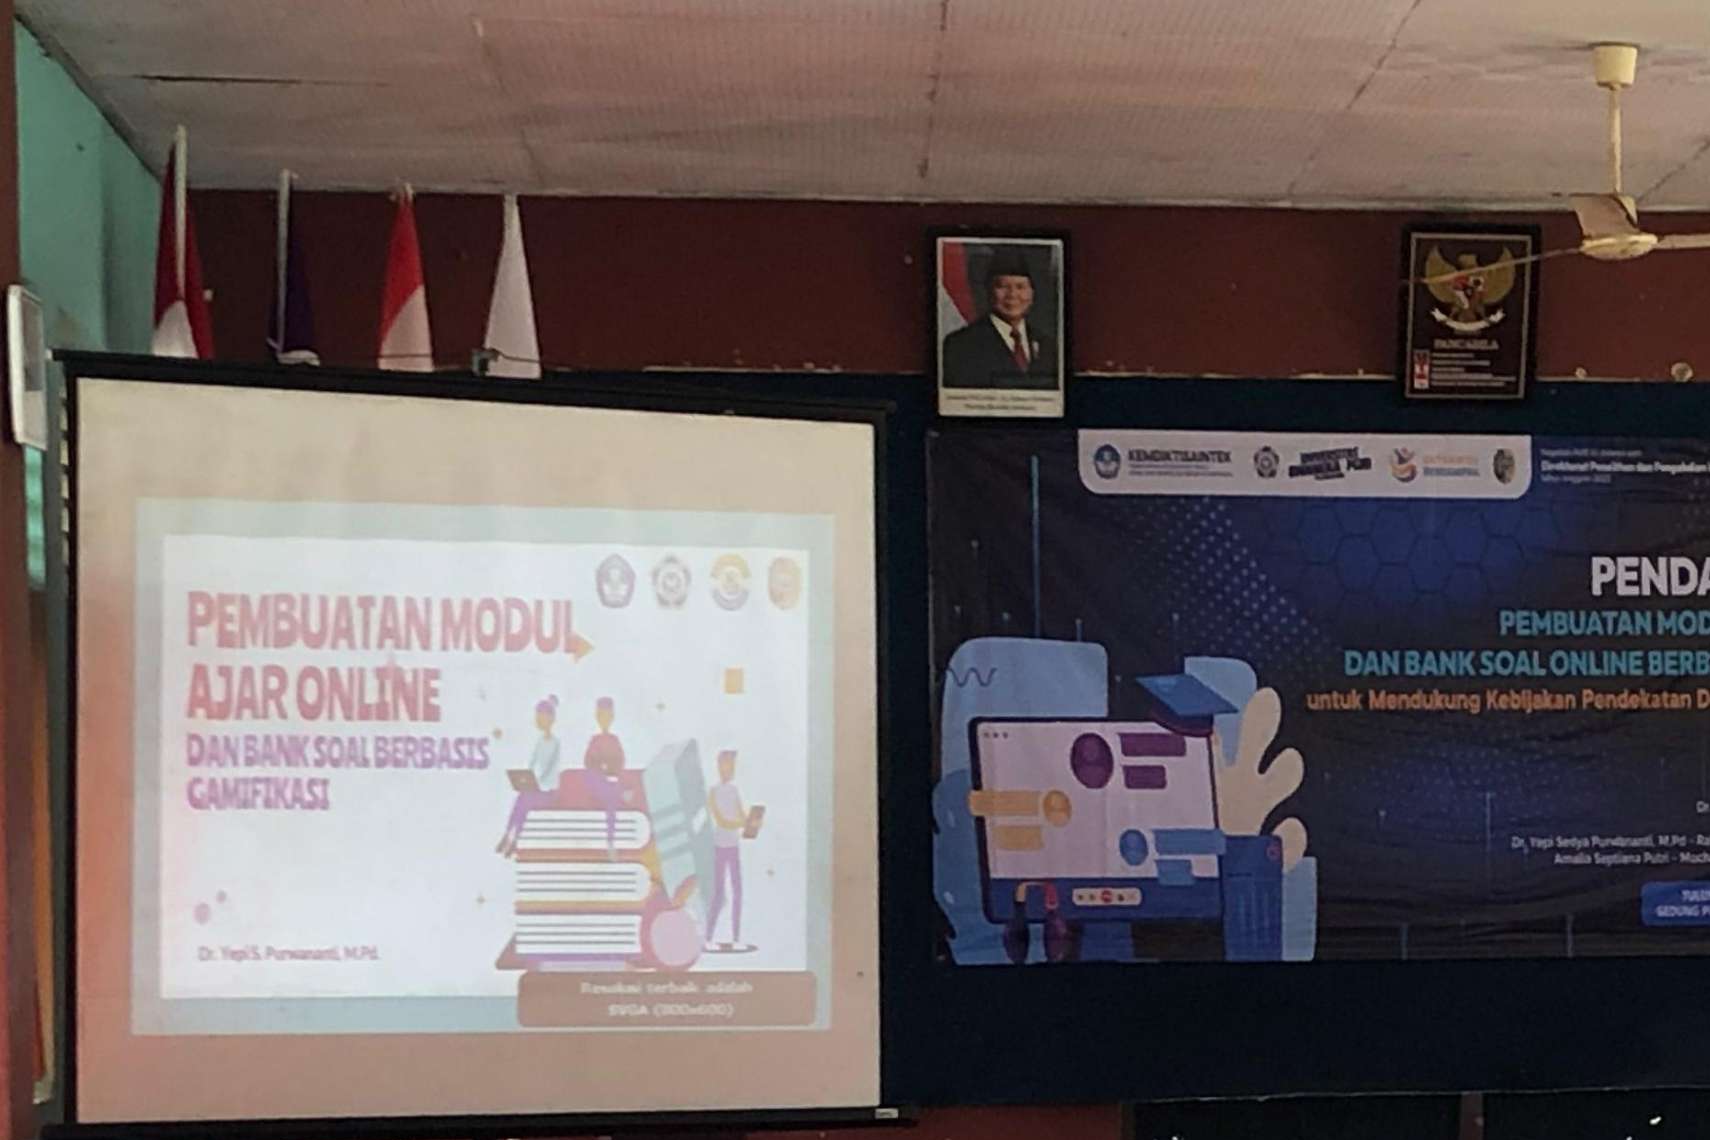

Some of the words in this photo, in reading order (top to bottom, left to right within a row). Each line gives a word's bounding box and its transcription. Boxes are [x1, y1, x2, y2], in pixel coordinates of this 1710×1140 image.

[187, 590, 432, 651] PEMBUATAN
[440, 597, 577, 654] MODUL
[1501, 609, 1653, 637] PEMBUATAN
[1344, 650, 1400, 676] DAN
[1403, 650, 1477, 676] BANK
[1479, 650, 1547, 676] SOAL
[1549, 650, 1645, 676] ONLINE
[186, 663, 289, 721] AJAR
[295, 665, 442, 723] ONLINE
[1306, 689, 1363, 710] untuk
[1368, 689, 1481, 714] Mendukung
[1486, 689, 1577, 714] Kebijakan
[1581, 688, 1692, 710] Pendekatan
[186, 732, 240, 768] DAN
[244, 734, 311, 769] BANK
[313, 735, 370, 769] SOAL
[373, 736, 491, 770] BERBASIS
[186, 776, 331, 811] GAMIFIKASI
